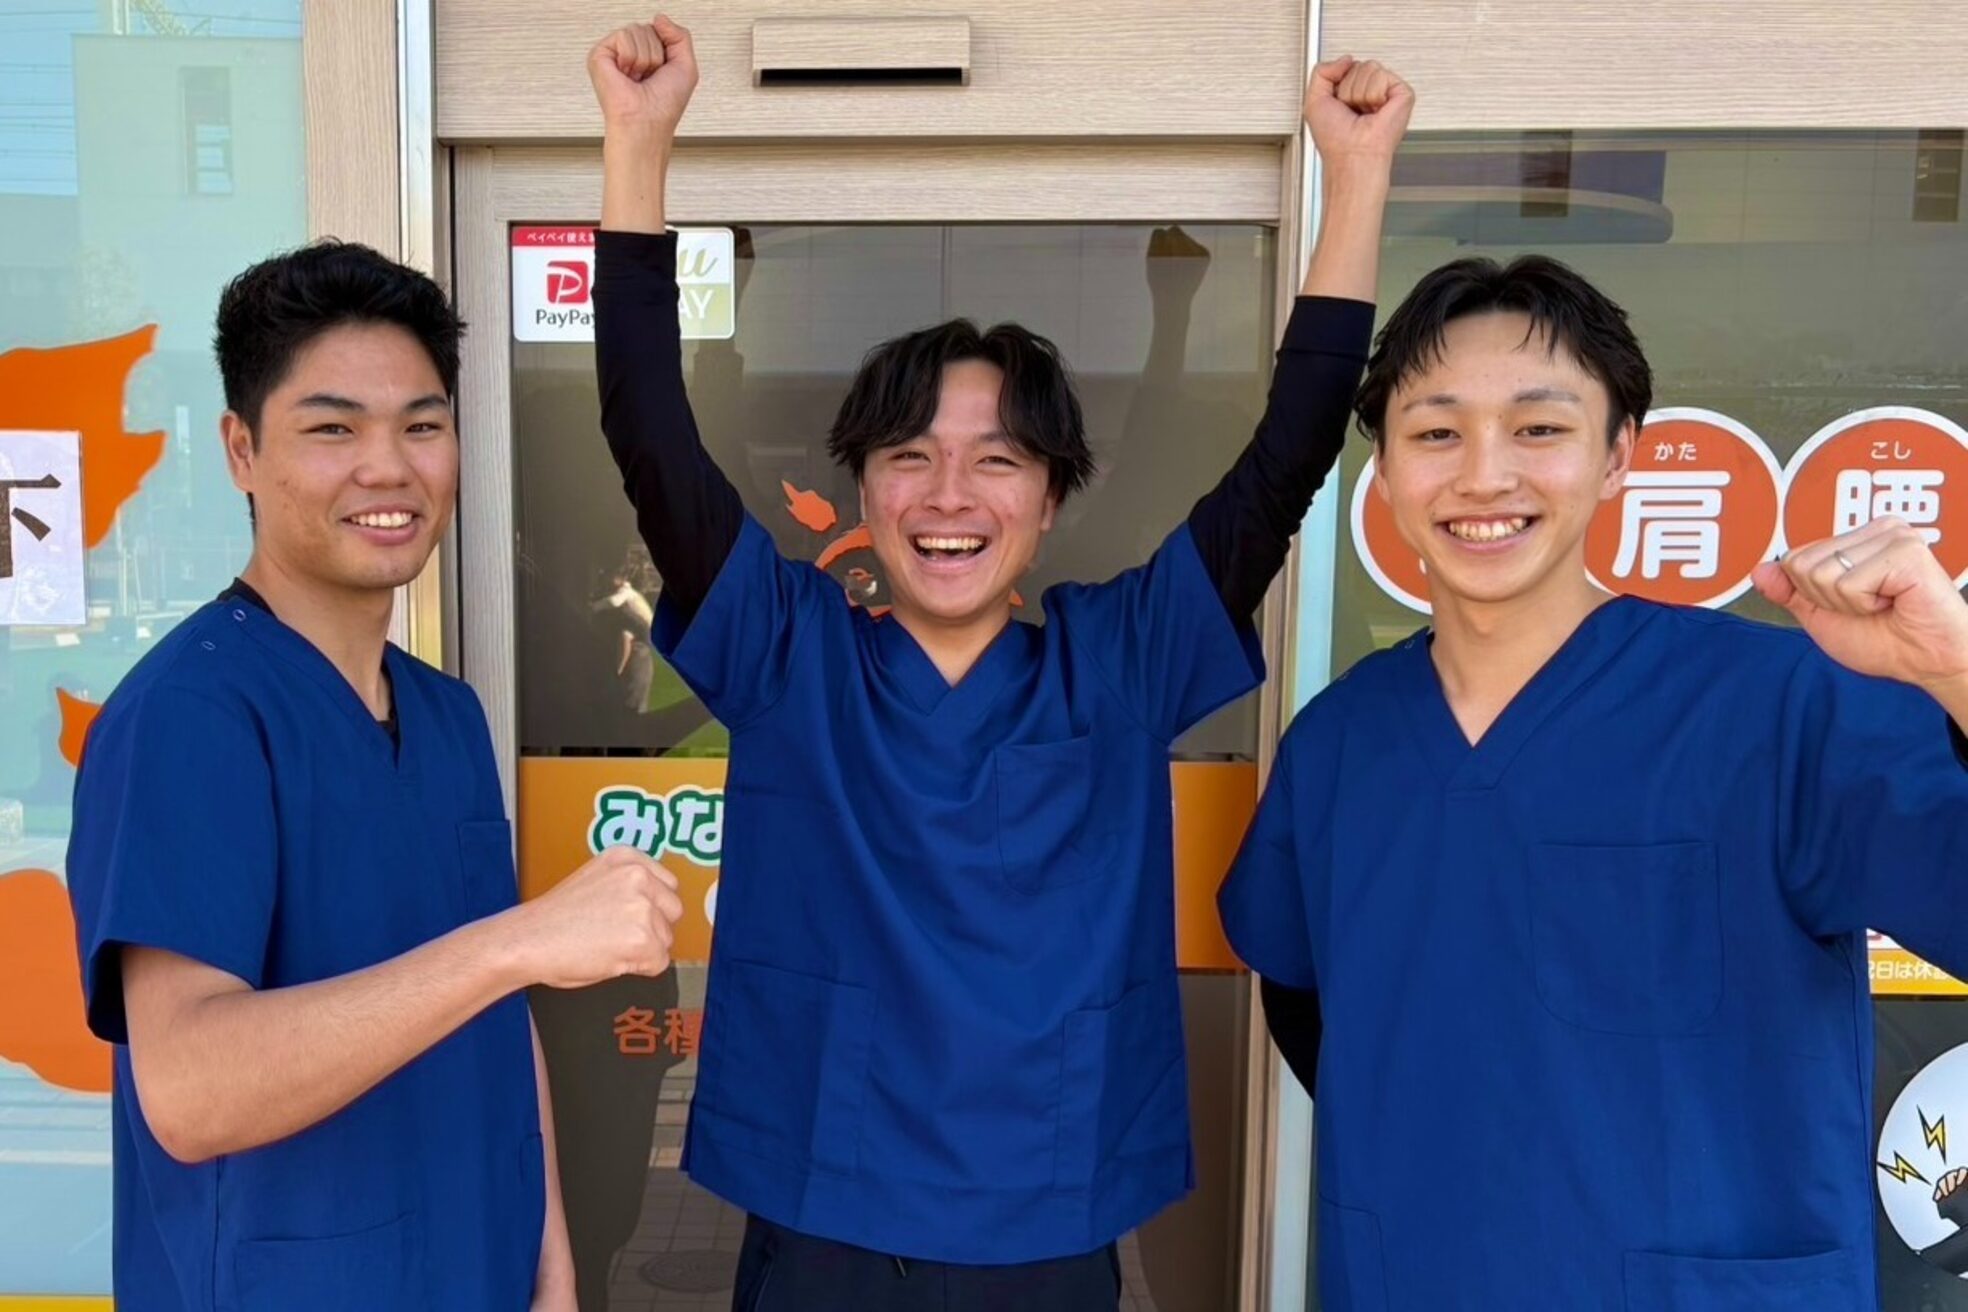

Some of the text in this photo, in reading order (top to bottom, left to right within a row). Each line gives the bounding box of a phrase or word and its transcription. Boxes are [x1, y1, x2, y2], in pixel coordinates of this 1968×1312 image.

[1654, 441, 1697, 461] かた
[1871, 442, 1912, 460] こし
[1611, 470, 1731, 579] 肩
[593, 788, 724, 860] みな
